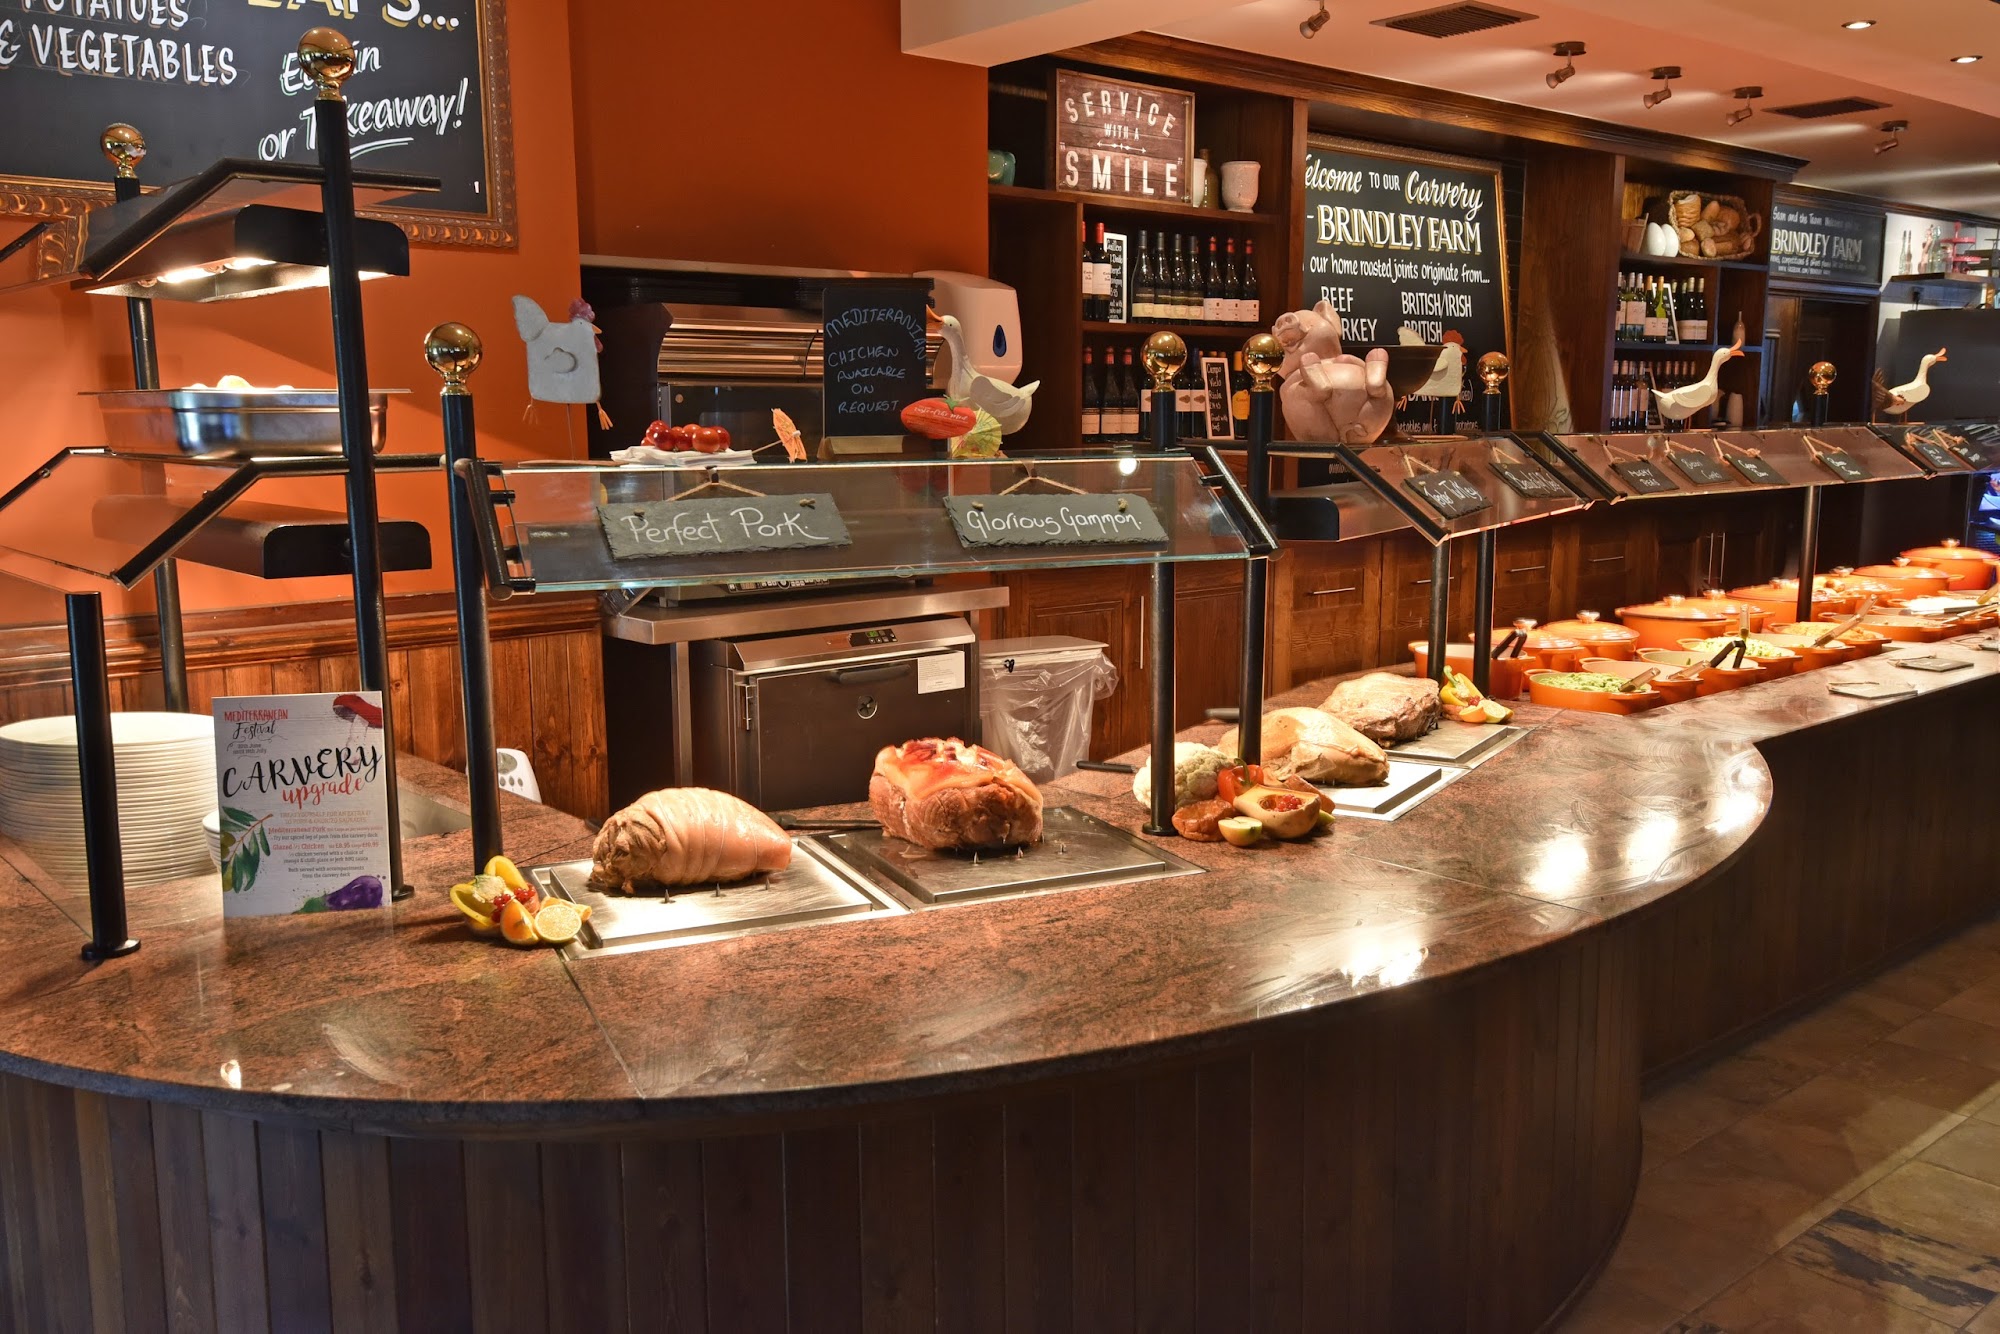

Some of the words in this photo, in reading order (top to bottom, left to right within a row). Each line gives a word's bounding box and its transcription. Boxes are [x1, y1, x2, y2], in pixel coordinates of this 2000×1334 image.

[30, 23, 238, 86] VEGETABLES
[261, 126, 297, 161] or
[300, 77, 469, 150] Tkeaway!
[1065, 90, 1176, 137] SERVICE
[1104, 123, 1129, 139] WITH
[1134, 128, 1140, 141] A
[1065, 151, 1178, 197] SMILE
[1305, 154, 1362, 193] elcome
[1368, 171, 1381, 189] TO
[1383, 173, 1400, 191] OUR
[1405, 170, 1484, 221] Carvery
[1317, 204, 1425, 250] BRINDLEY
[1427, 217, 1482, 255] FARM
[1788, 211, 1799, 223] and
[1771, 228, 1831, 258] BRINDLEY
[1831, 236, 1863, 263] FARM
[1310, 256, 1329, 274] our
[1331, 253, 1359, 275] home
[1360, 257, 1392, 278] roasted
[1391, 258, 1418, 284] joints
[1421, 261, 1459, 286] originate
[1321, 285, 1354, 313] BEEF
[1401, 290, 1472, 319] BRITISH/IRISH
[825, 308, 927, 360] MEDITERANIAN
[1342, 318, 1378, 342] RKEY
[837, 366, 906, 382] AVAILABLE
[851, 383, 874, 394] ON
[838, 400, 899, 414] REQUEST
[620, 511, 723, 546] Perfect
[966, 510, 1062, 539] Glorious
[1059, 506, 1143, 537] Gammon.
[224, 709, 289, 721] MEDITERRANEAN
[232, 720, 276, 740] Festival
[222, 744, 383, 798] CARVERY
[282, 772, 363, 810] upgrade
